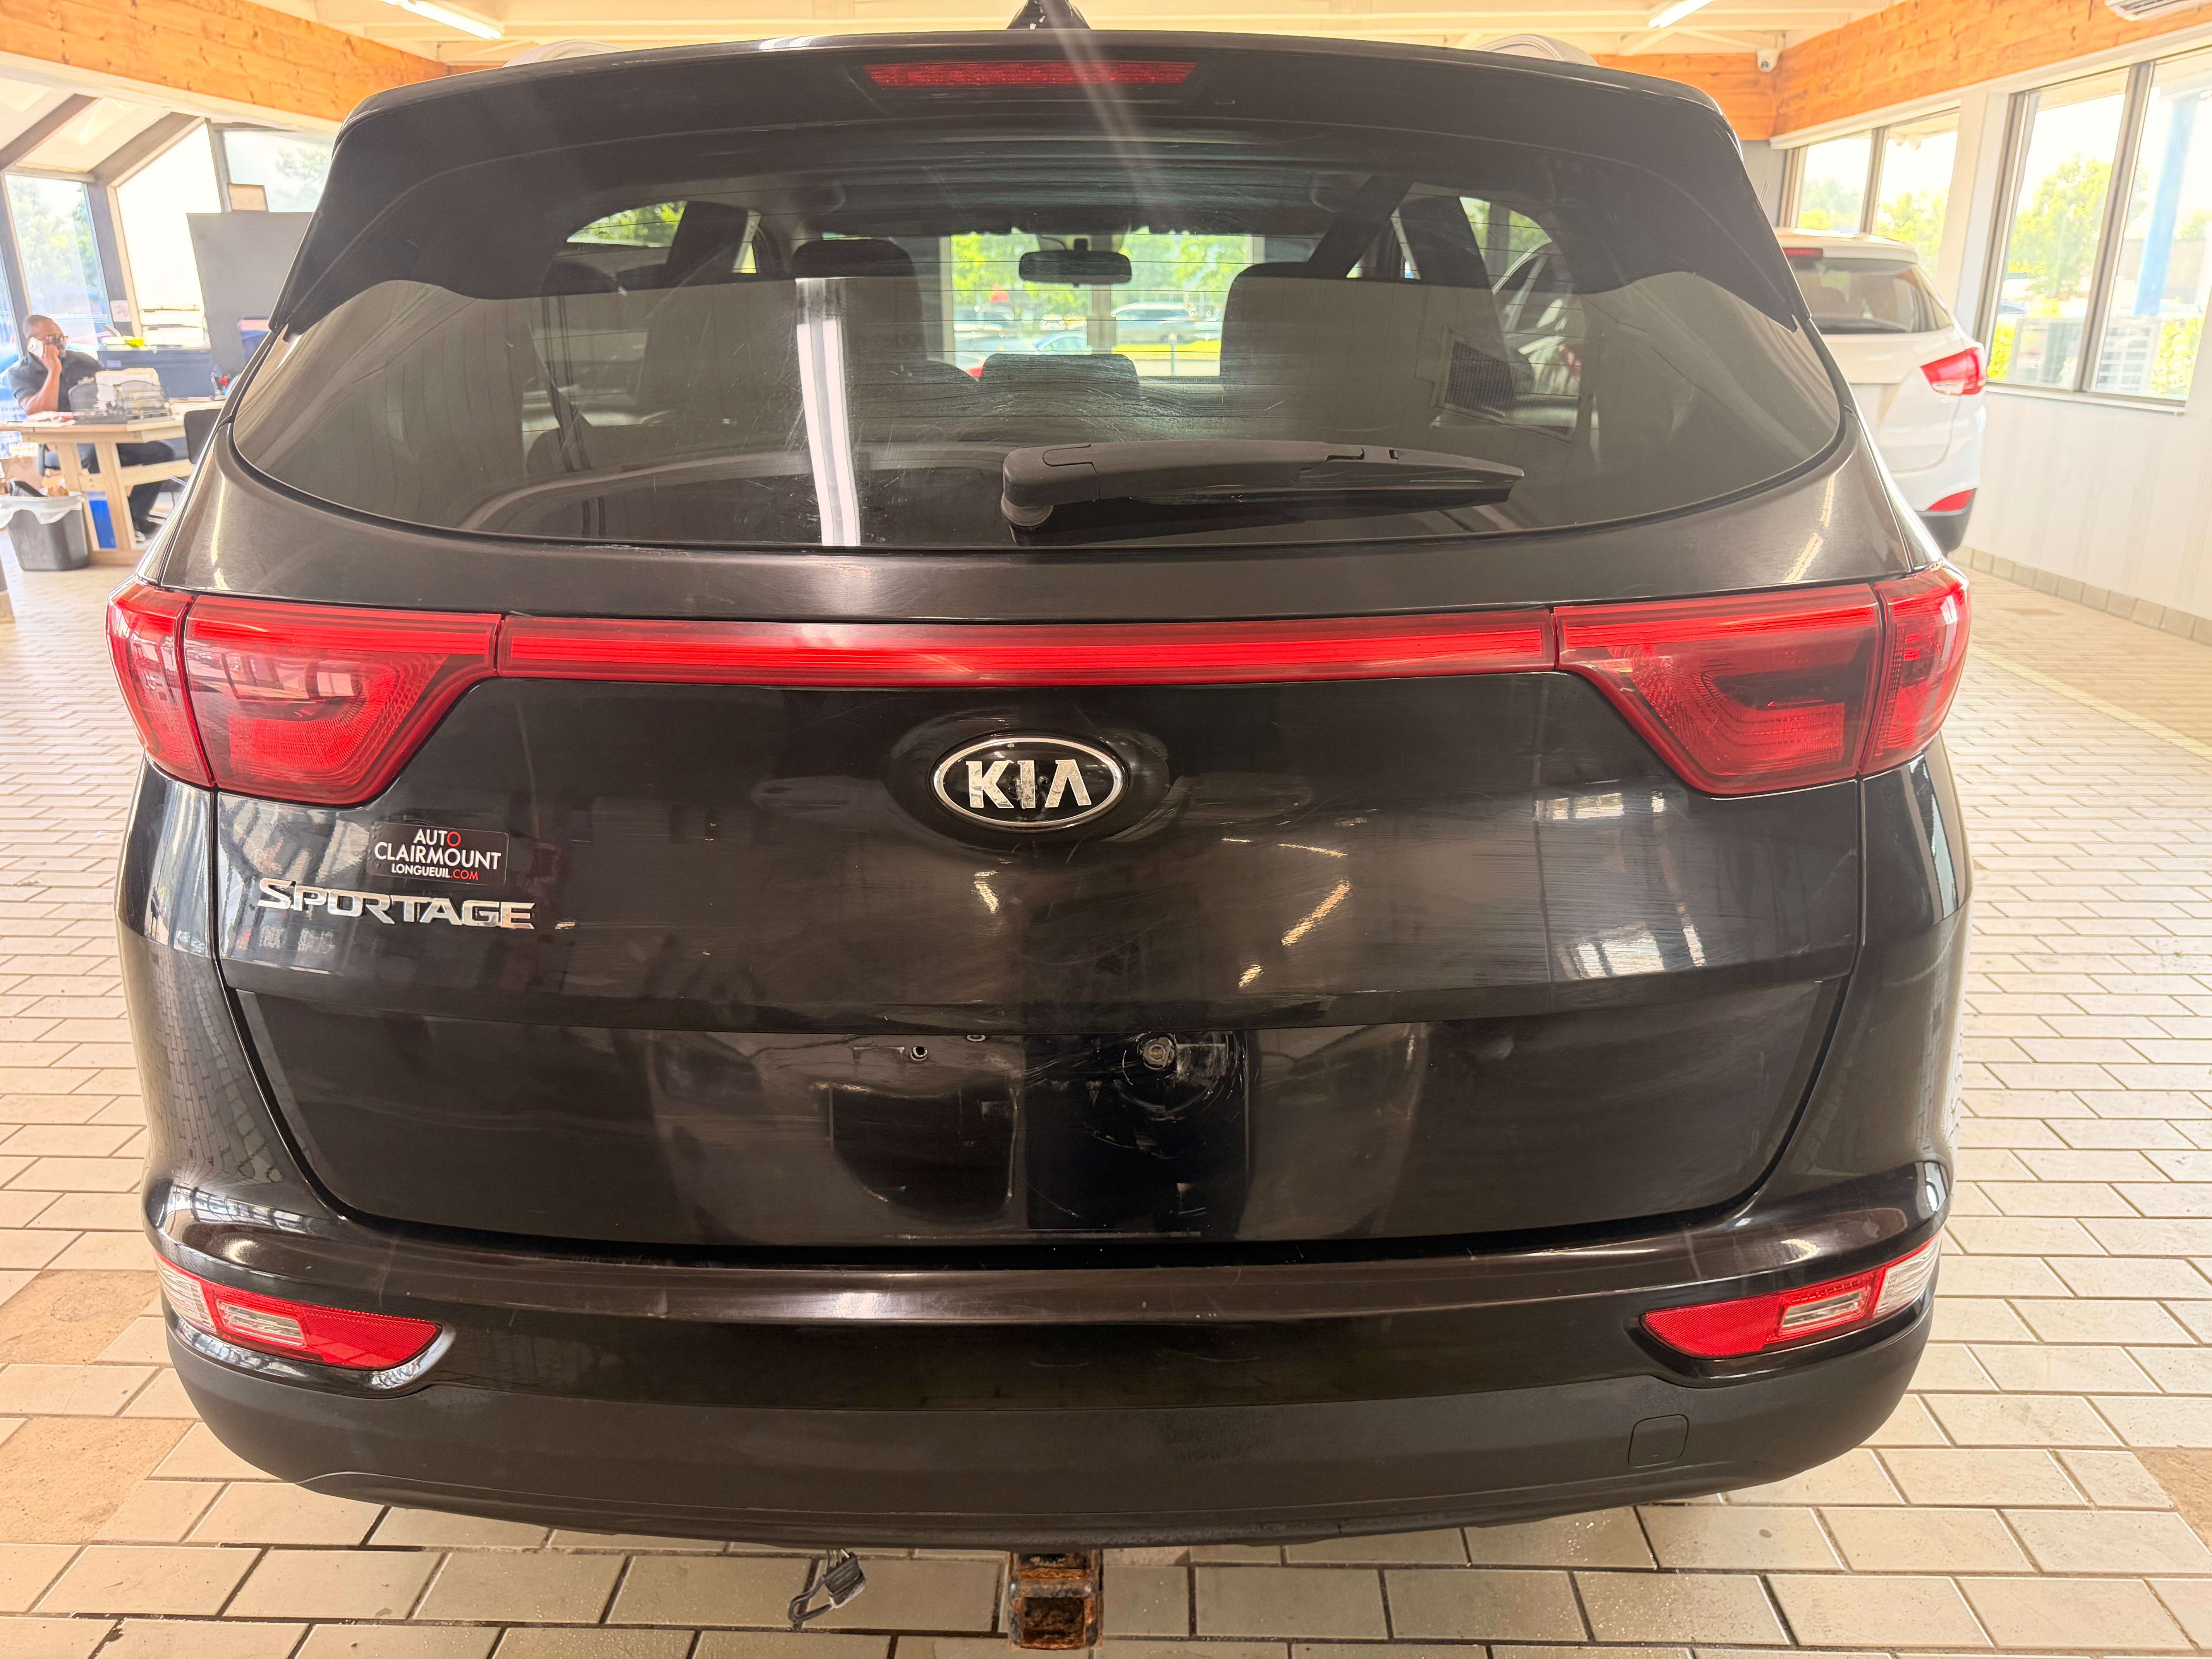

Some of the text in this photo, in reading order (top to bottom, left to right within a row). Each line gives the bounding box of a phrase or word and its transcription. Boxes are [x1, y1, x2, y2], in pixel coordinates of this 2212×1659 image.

[966, 759, 1092, 809] KIA
[414, 828, 462, 847] AUTO
[374, 842, 501, 870] CLAIRMOUNT
[391, 862, 479, 881] LONGUEUIL.COM
[257, 877, 536, 929] SPORTAGE
